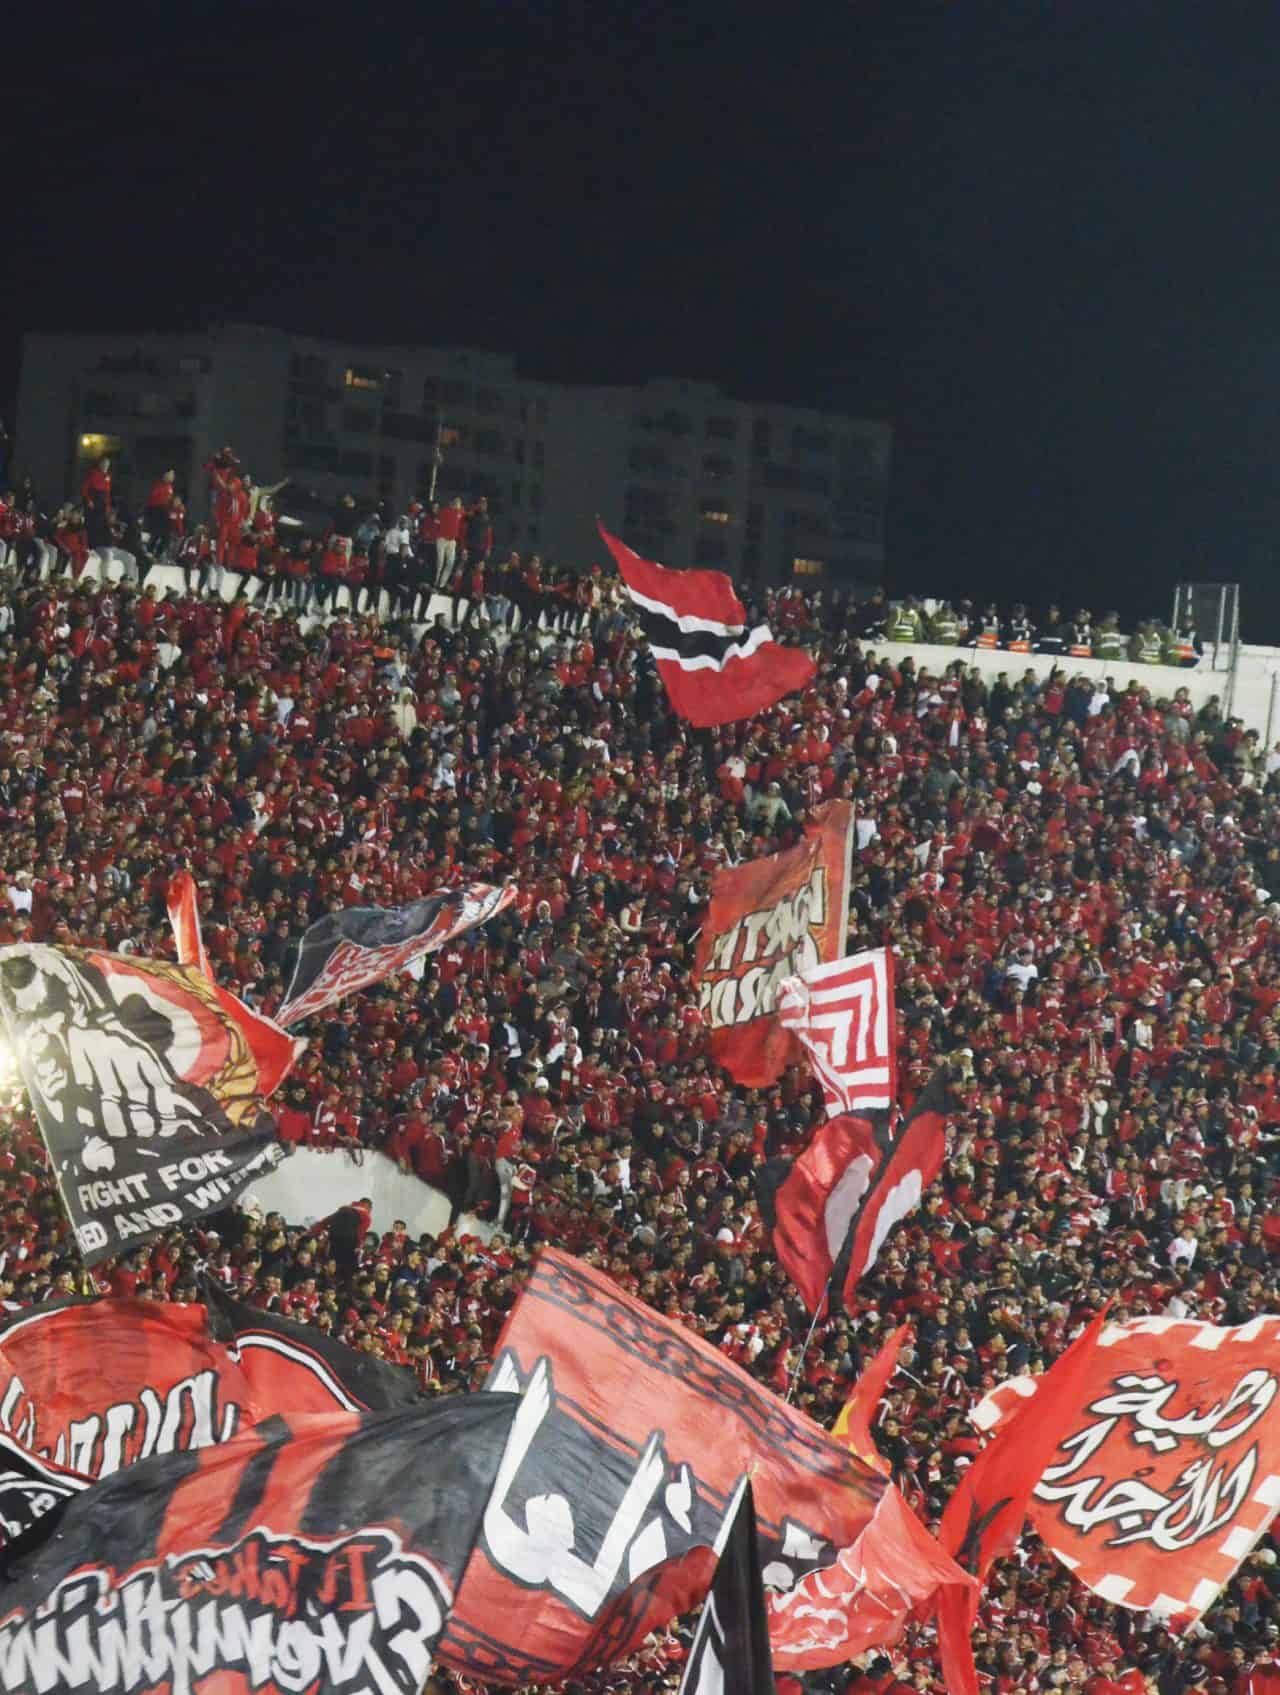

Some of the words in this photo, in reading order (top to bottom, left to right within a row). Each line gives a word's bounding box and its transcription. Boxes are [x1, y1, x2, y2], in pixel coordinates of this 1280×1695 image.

[77, 1172, 151, 1213] FIGHT
[157, 1149, 233, 1192] FOR
[113, 1202, 184, 1241] AND
